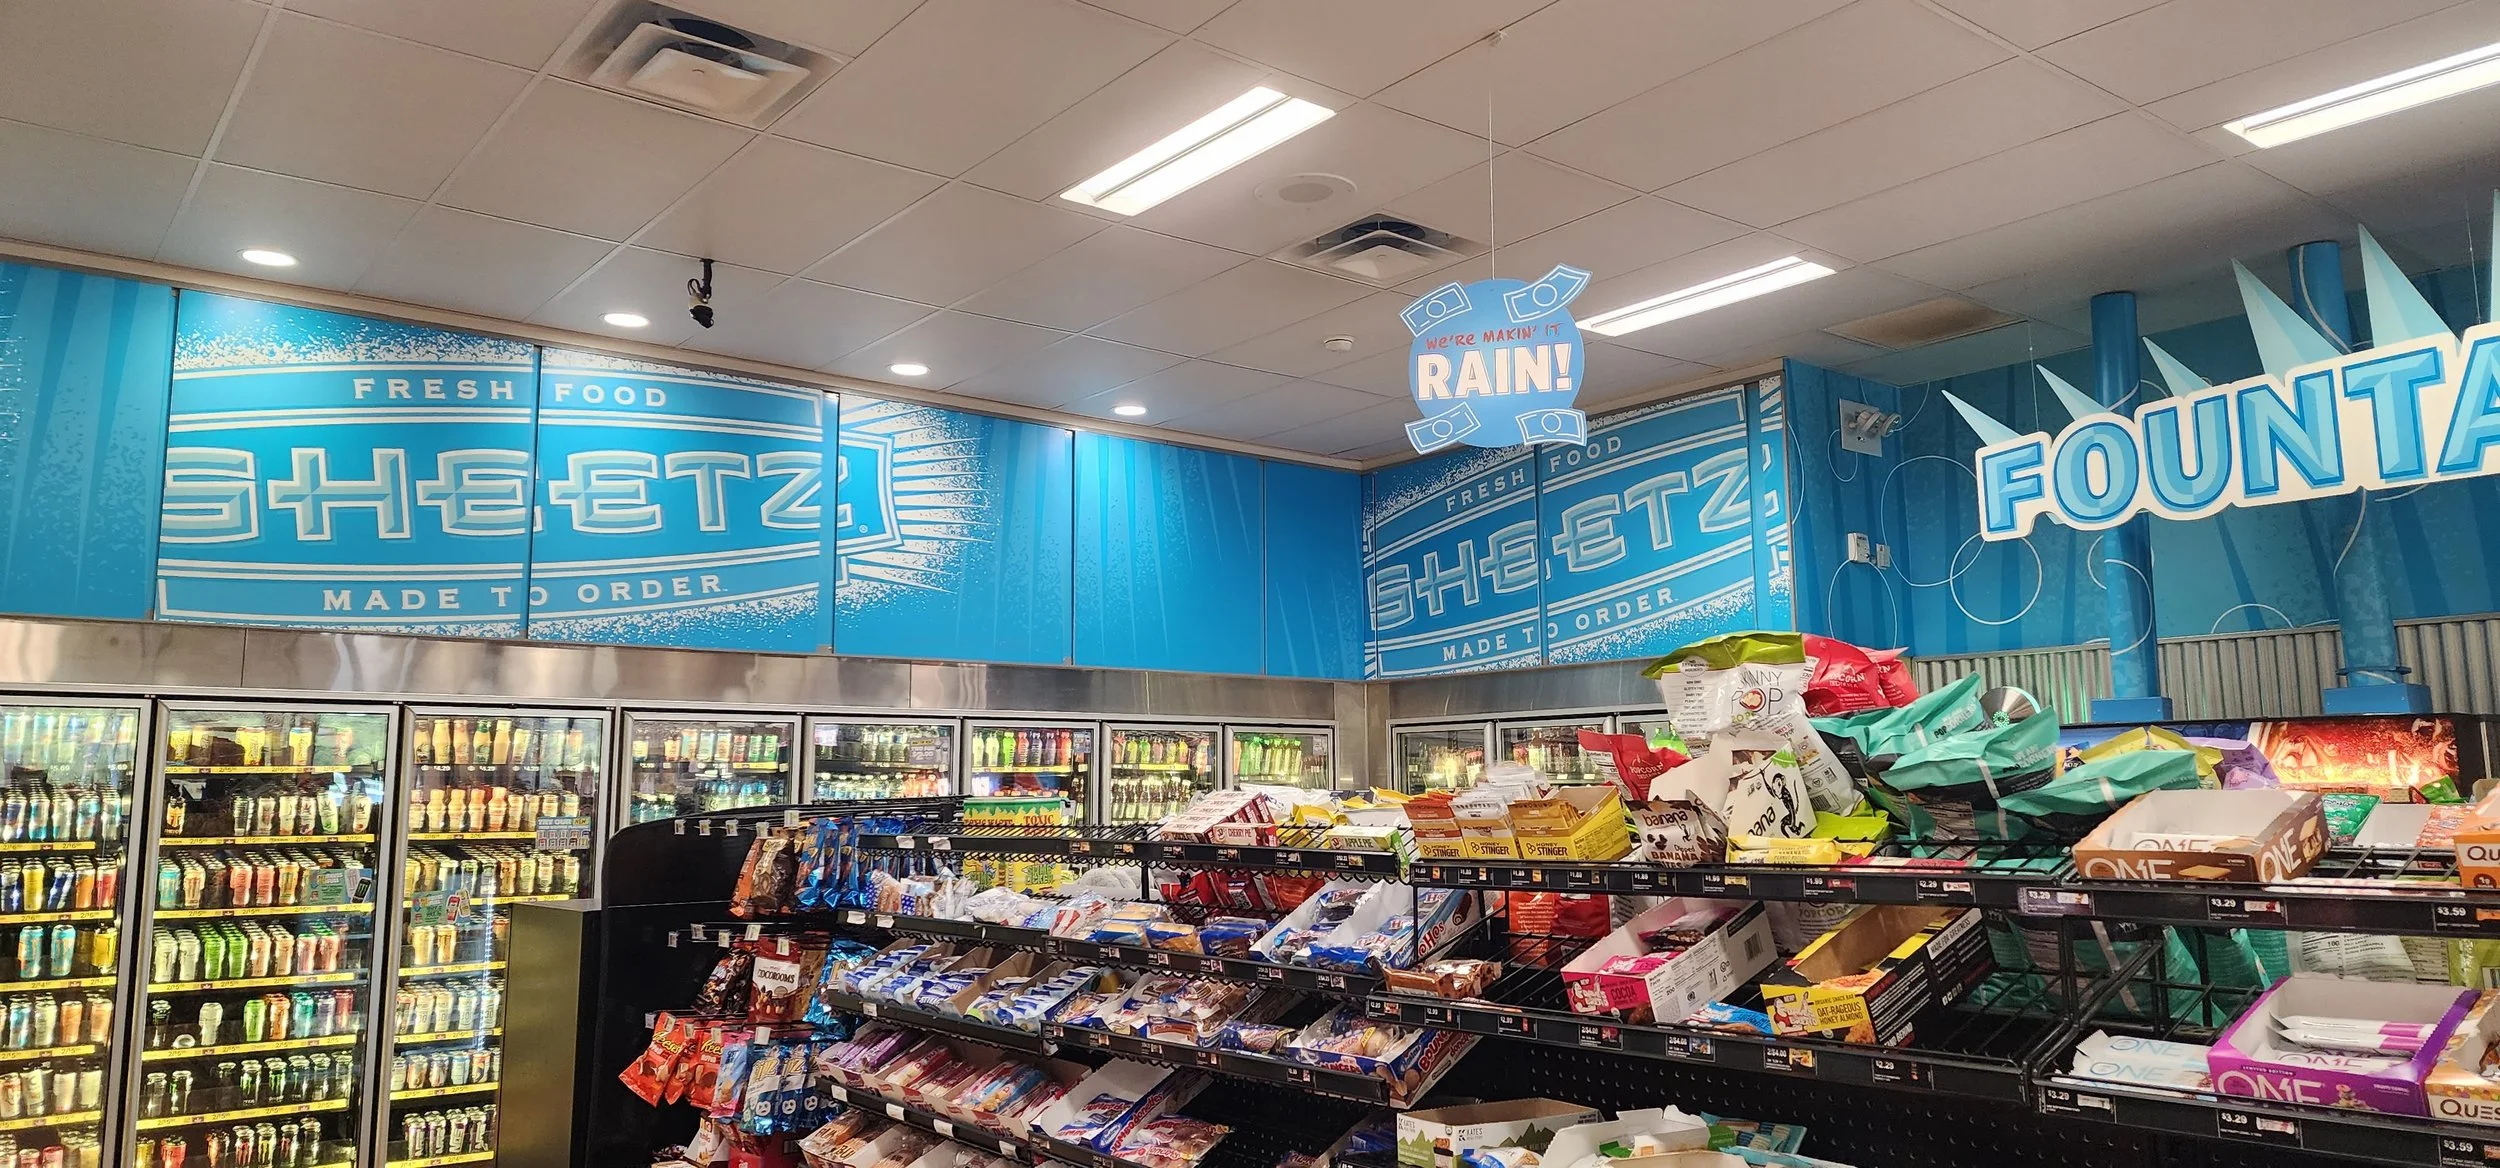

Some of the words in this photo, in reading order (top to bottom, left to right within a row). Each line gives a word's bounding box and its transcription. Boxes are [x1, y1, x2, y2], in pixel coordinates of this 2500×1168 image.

[1483, 324, 1539, 343] MAKIN'
[1543, 322, 1564, 337] IT
[1416, 343, 1573, 400] RAIN!
[354, 377, 515, 401] FRESH
[554, 384, 667, 408] FOOD
[1445, 468, 1526, 513] FRESH
[1548, 436, 1622, 473] FOOD
[162, 446, 855, 544] SHEETZ
[1366, 446, 1781, 631] SHEETZ
[322, 587, 462, 612] MADE
[491, 584, 549, 607] TO
[576, 575, 722, 602] ORDER
[1442, 635, 1509, 662] MADE
[1522, 622, 1559, 645] TO
[1575, 588, 1675, 631] ORDER
[1738, 668, 1783, 689] SKINNY
[1023, 814, 1054, 825] TOXIC
[1227, 828, 1244, 838] CHERRY
[1345, 837, 1360, 848] APPLE
[1480, 846, 1510, 855] STINGER
[1432, 848, 1460, 857] STINGER
[1537, 847, 1568, 857] STINGER
[1650, 850, 1700, 862] BANANA
[2260, 828, 2302, 883] ONE
[2084, 857, 2176, 880] ONE
[2028, 890, 2051, 900] $3.29
[2211, 897, 2237, 908] $3.29
[2437, 906, 2467, 917] $3.59
[1610, 984, 1637, 1001] COCOA
[1817, 1001, 1862, 1018] OAT-RAGEOUS
[1819, 1014, 1839, 1026] HONEY
[1839, 1011, 1865, 1023] ALMOND
[2110, 1038, 2184, 1057] ONE
[2089, 1061, 2174, 1081] ONE
[2217, 1070, 2323, 1105] ONE
[2221, 1112, 2248, 1125] $3.29
[2443, 1139, 2474, 1153] $3.59
